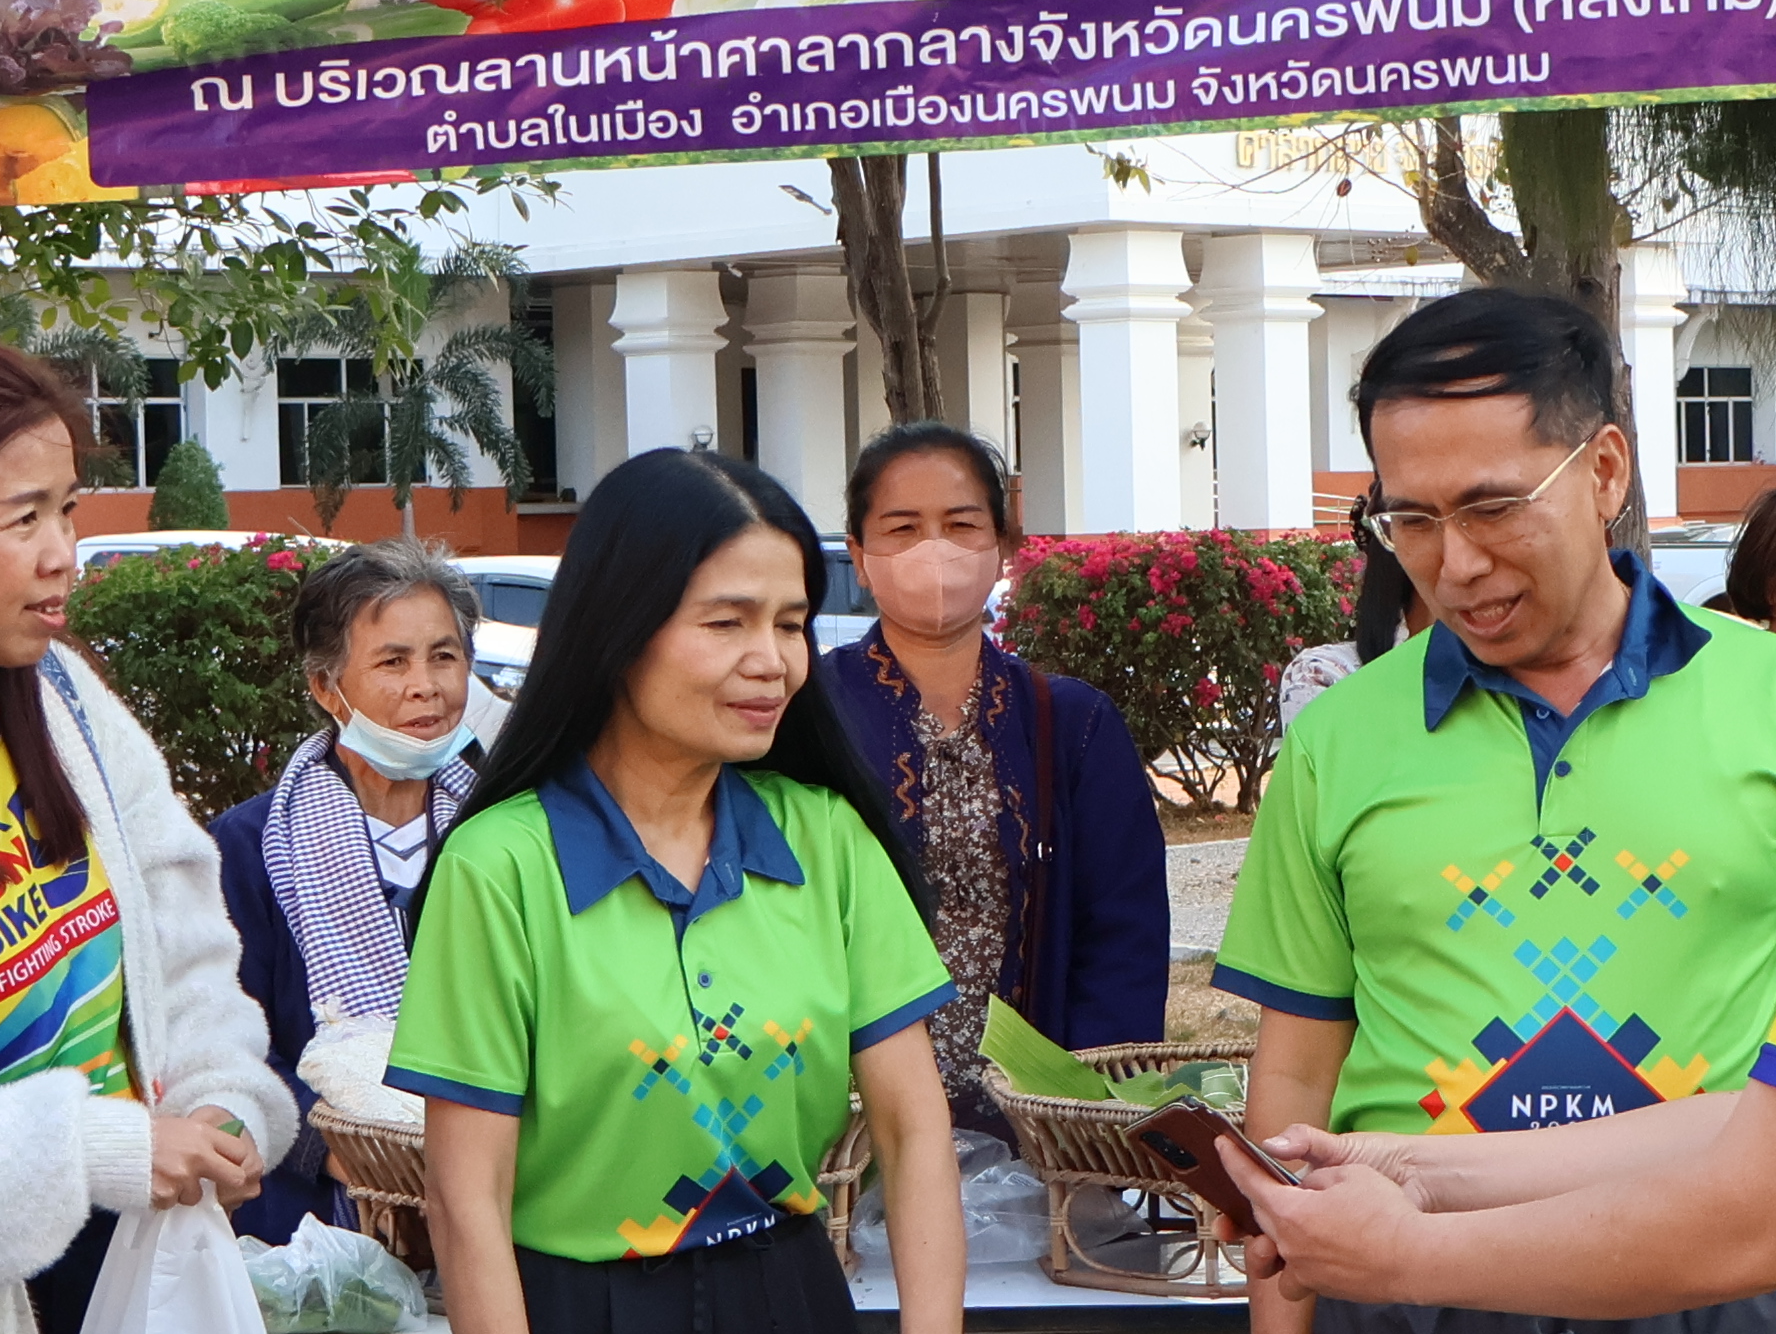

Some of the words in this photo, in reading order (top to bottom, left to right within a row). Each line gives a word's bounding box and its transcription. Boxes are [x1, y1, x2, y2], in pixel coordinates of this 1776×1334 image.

[193, 75, 252, 112] ณ
[427, 102, 703, 153] ตำบลในเมือง
[732, 78, 1176, 134] อำเภอเมืองนครพนม
[1192, 48, 1551, 107] จังหวัดนครพนม
[60, 898, 116, 944] STROKE
[1511, 1094, 1615, 1118] NPKM
